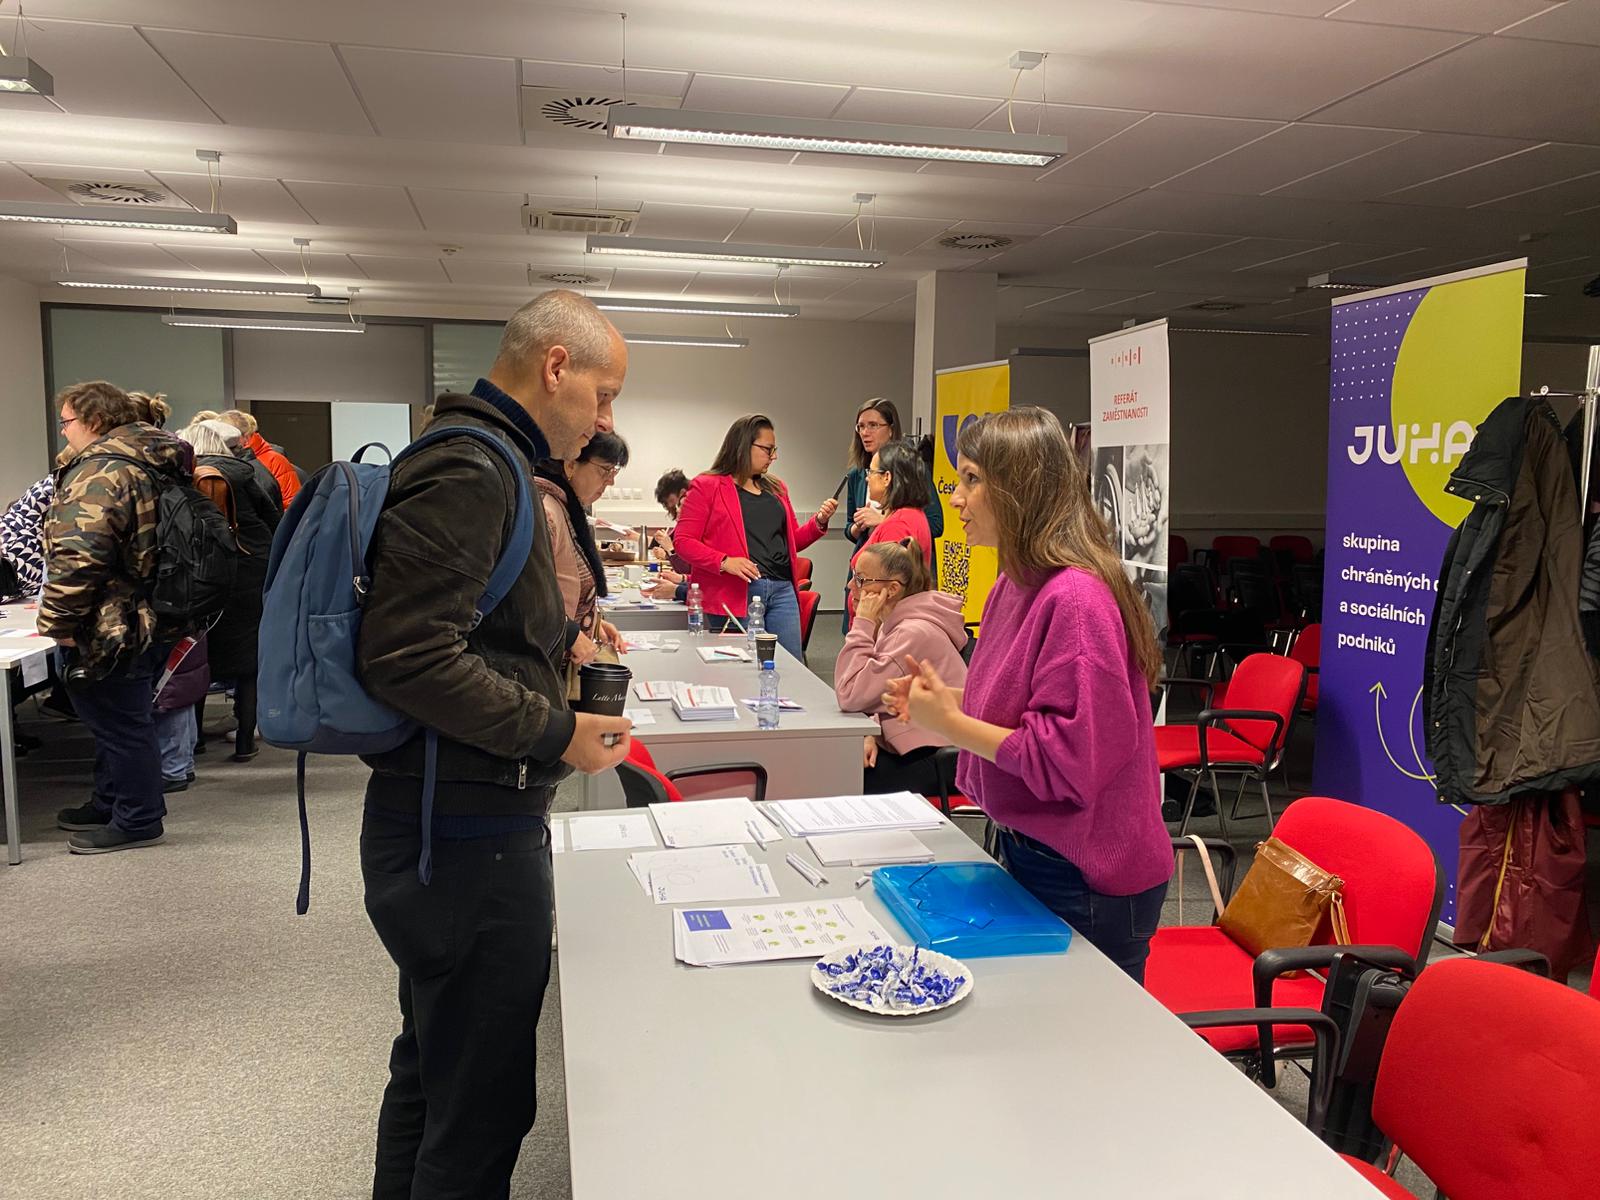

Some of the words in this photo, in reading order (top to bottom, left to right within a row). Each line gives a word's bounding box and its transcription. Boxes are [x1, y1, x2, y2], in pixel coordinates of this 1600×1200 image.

[1113, 390, 1138, 405] REFERÁT
[1102, 406, 1149, 422] ZAMĚSTNANOSTI
[1343, 532, 1400, 554] skupina
[1341, 565, 1431, 592] chráněných
[1340, 601, 1348, 613] a
[1350, 602, 1425, 626] sociálních
[1338, 633, 1396, 655] podniků
